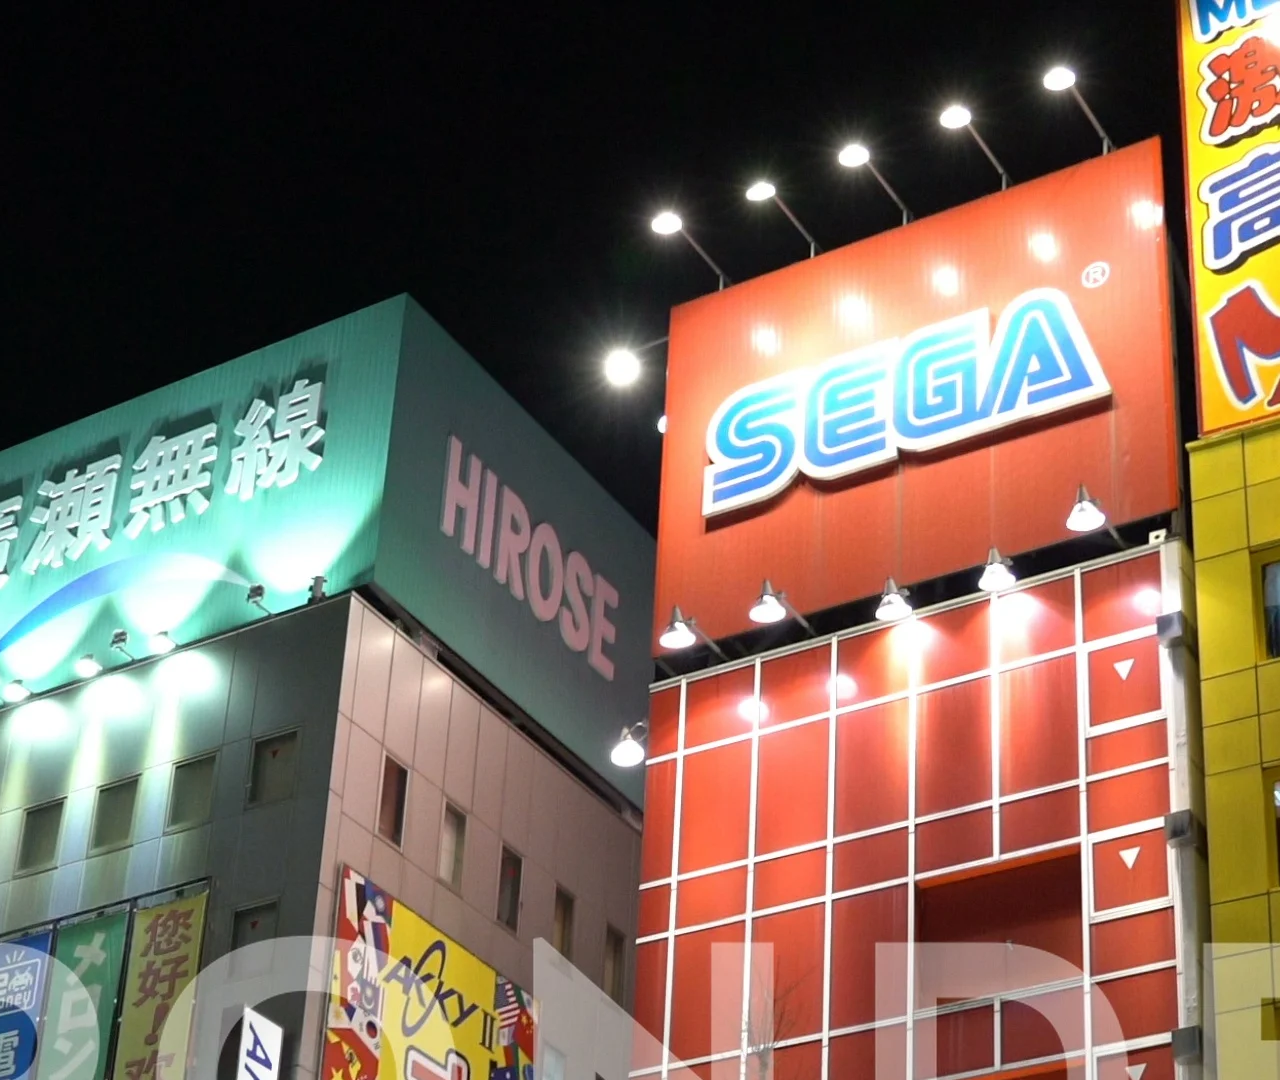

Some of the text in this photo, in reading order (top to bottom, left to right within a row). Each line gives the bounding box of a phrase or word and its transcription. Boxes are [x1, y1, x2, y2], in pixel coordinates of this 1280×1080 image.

[703, 289, 1111, 516] SEGA
[440, 433, 620, 681] HIROSE
[384, 945, 480, 1035] AKKY
